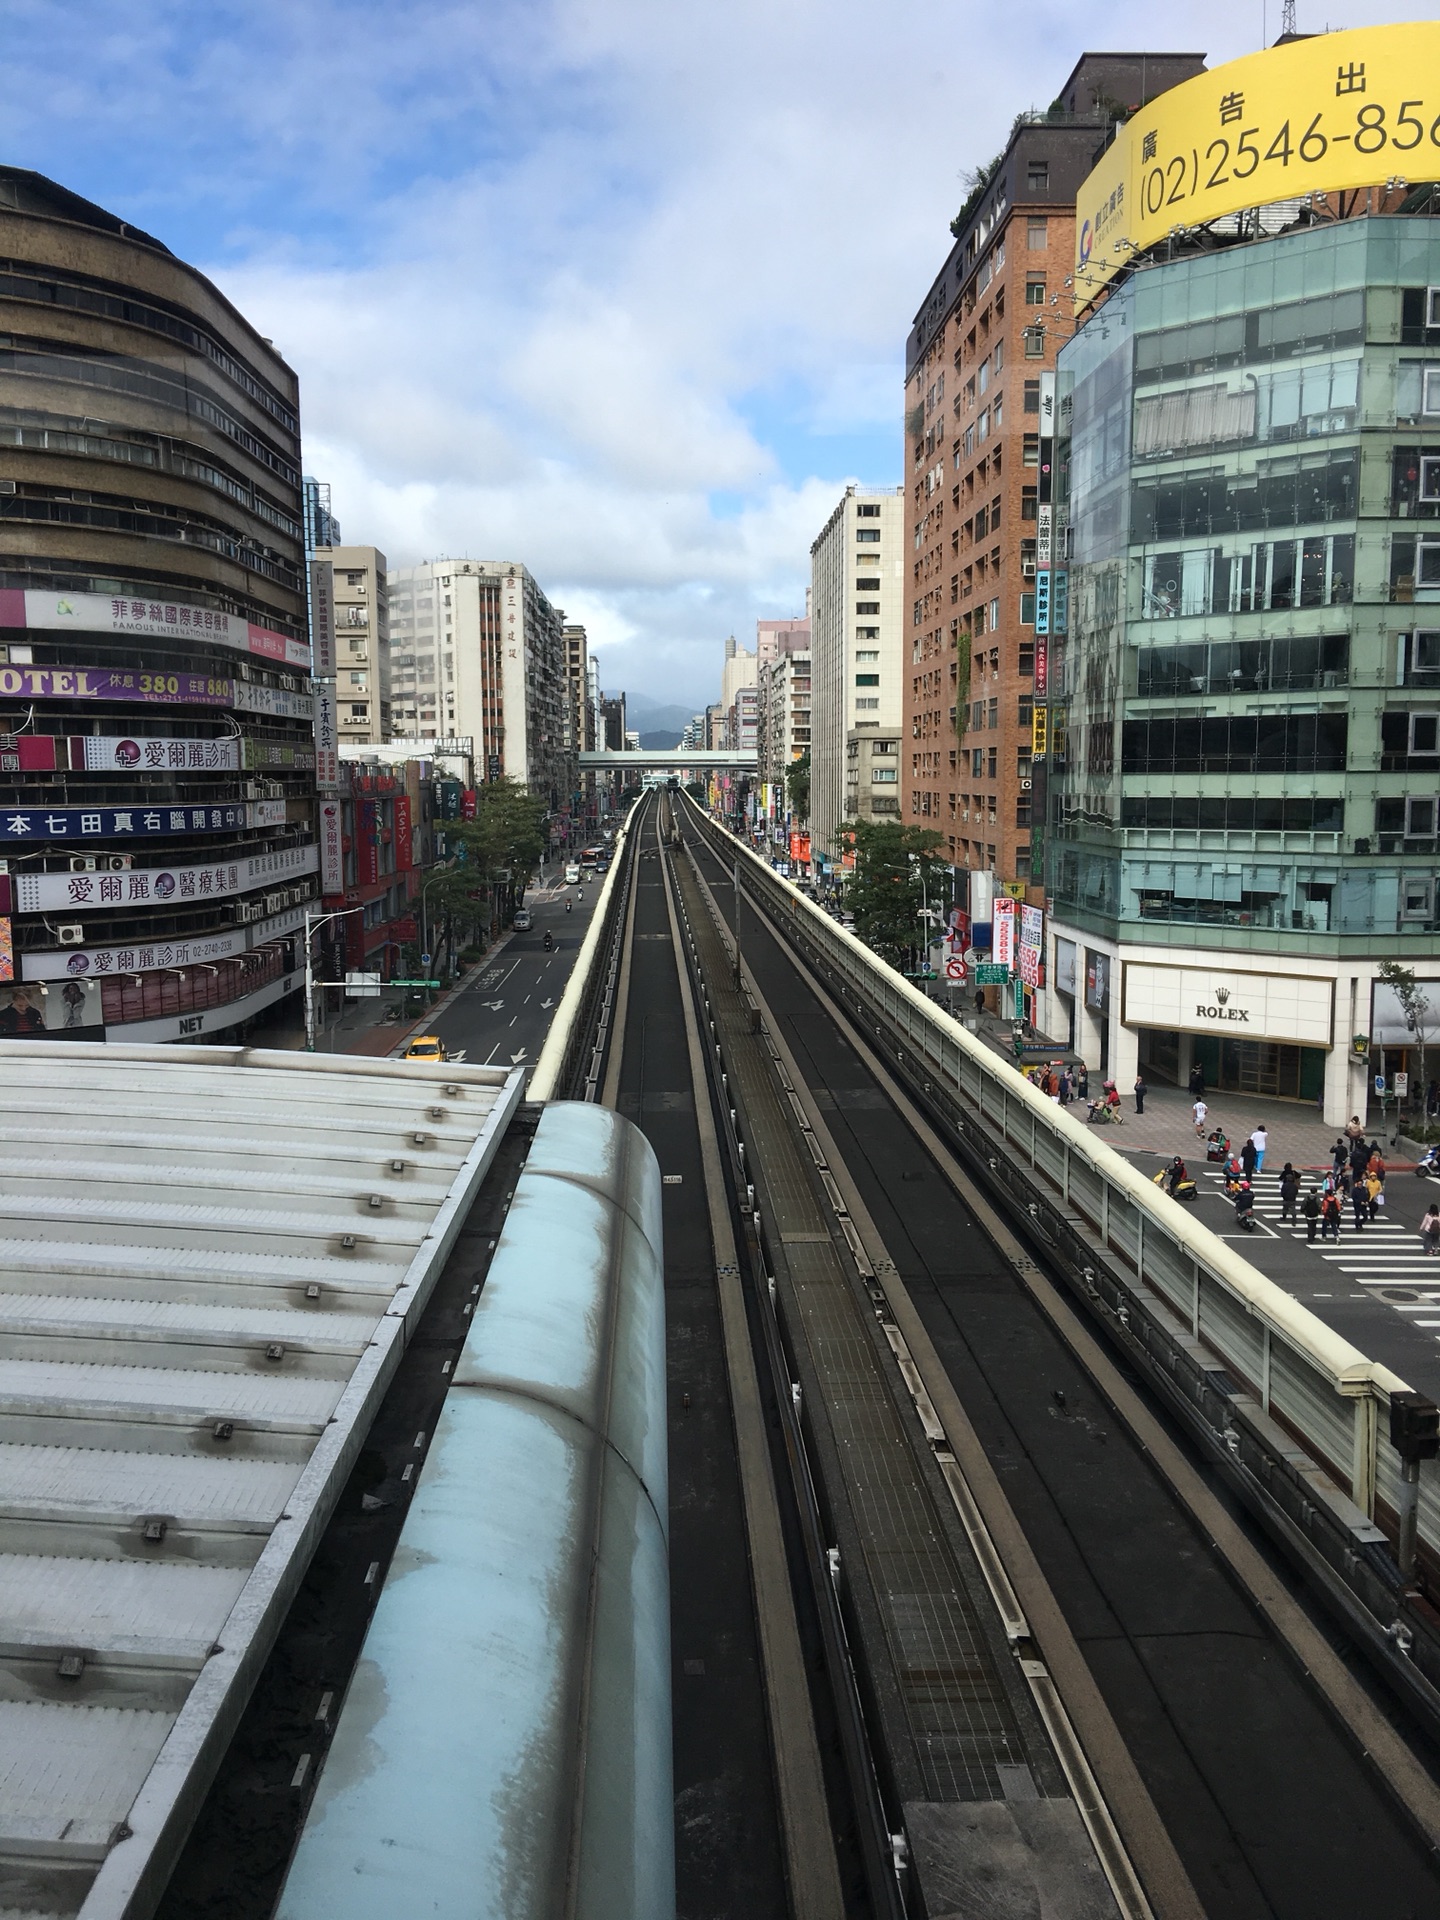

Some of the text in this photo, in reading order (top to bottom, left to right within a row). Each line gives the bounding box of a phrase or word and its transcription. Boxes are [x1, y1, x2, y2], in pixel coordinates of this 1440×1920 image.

[111, 599, 229, 633] 菲夢絲國際美容機構
[113, 621, 155, 633] FAMOUS
[109, 673, 134, 688] 休息
[139, 676, 179, 694] 380
[189, 680, 205, 693] 住宿
[207, 679, 229, 696] 880
[144, 740, 231, 769] 愛爾麗診所
[1034, 754, 1046, 762] 5F
[6, 809, 244, 836] 本七田真右腦開發中心
[397, 801, 408, 845] TASTY
[326, 818, 339, 881] 愛爾麗診所
[67, 865, 239, 905] 愛爾麗 醫療集團
[996, 899, 1013, 914] 租
[94, 943, 190, 973] 愛爾麗診所
[179, 1015, 204, 1034] NET
[1196, 1004, 1250, 1022] ROLEX
